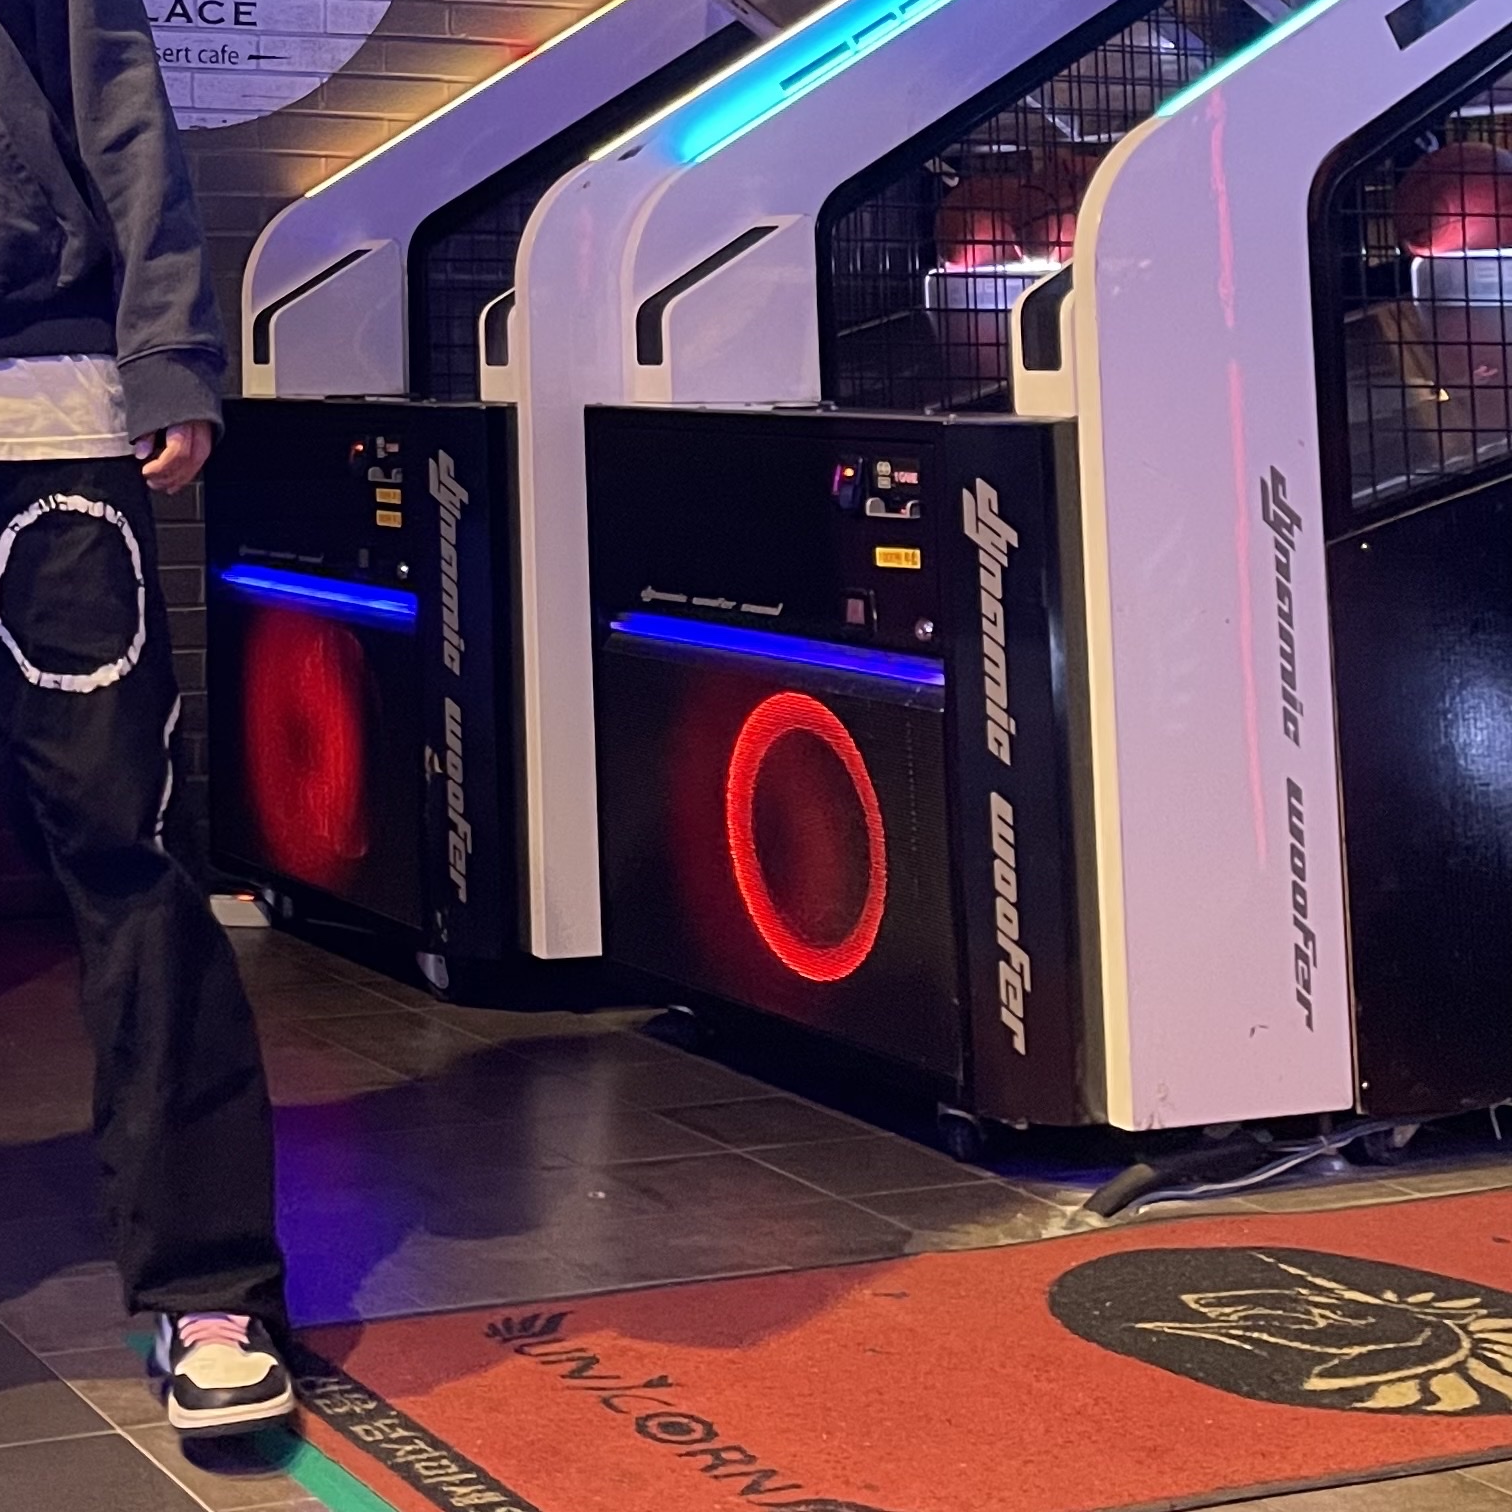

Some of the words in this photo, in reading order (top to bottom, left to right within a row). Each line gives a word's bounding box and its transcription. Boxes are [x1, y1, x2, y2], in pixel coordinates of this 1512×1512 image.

[156, 45, 192, 64] sert
[197, 44, 239, 65] cafe
[443, 696, 473, 904] woofer
[989, 791, 1032, 1056] woofer
[1286, 776, 1319, 1033] woofer
[514, 1338, 804, 1497] UNICORN
